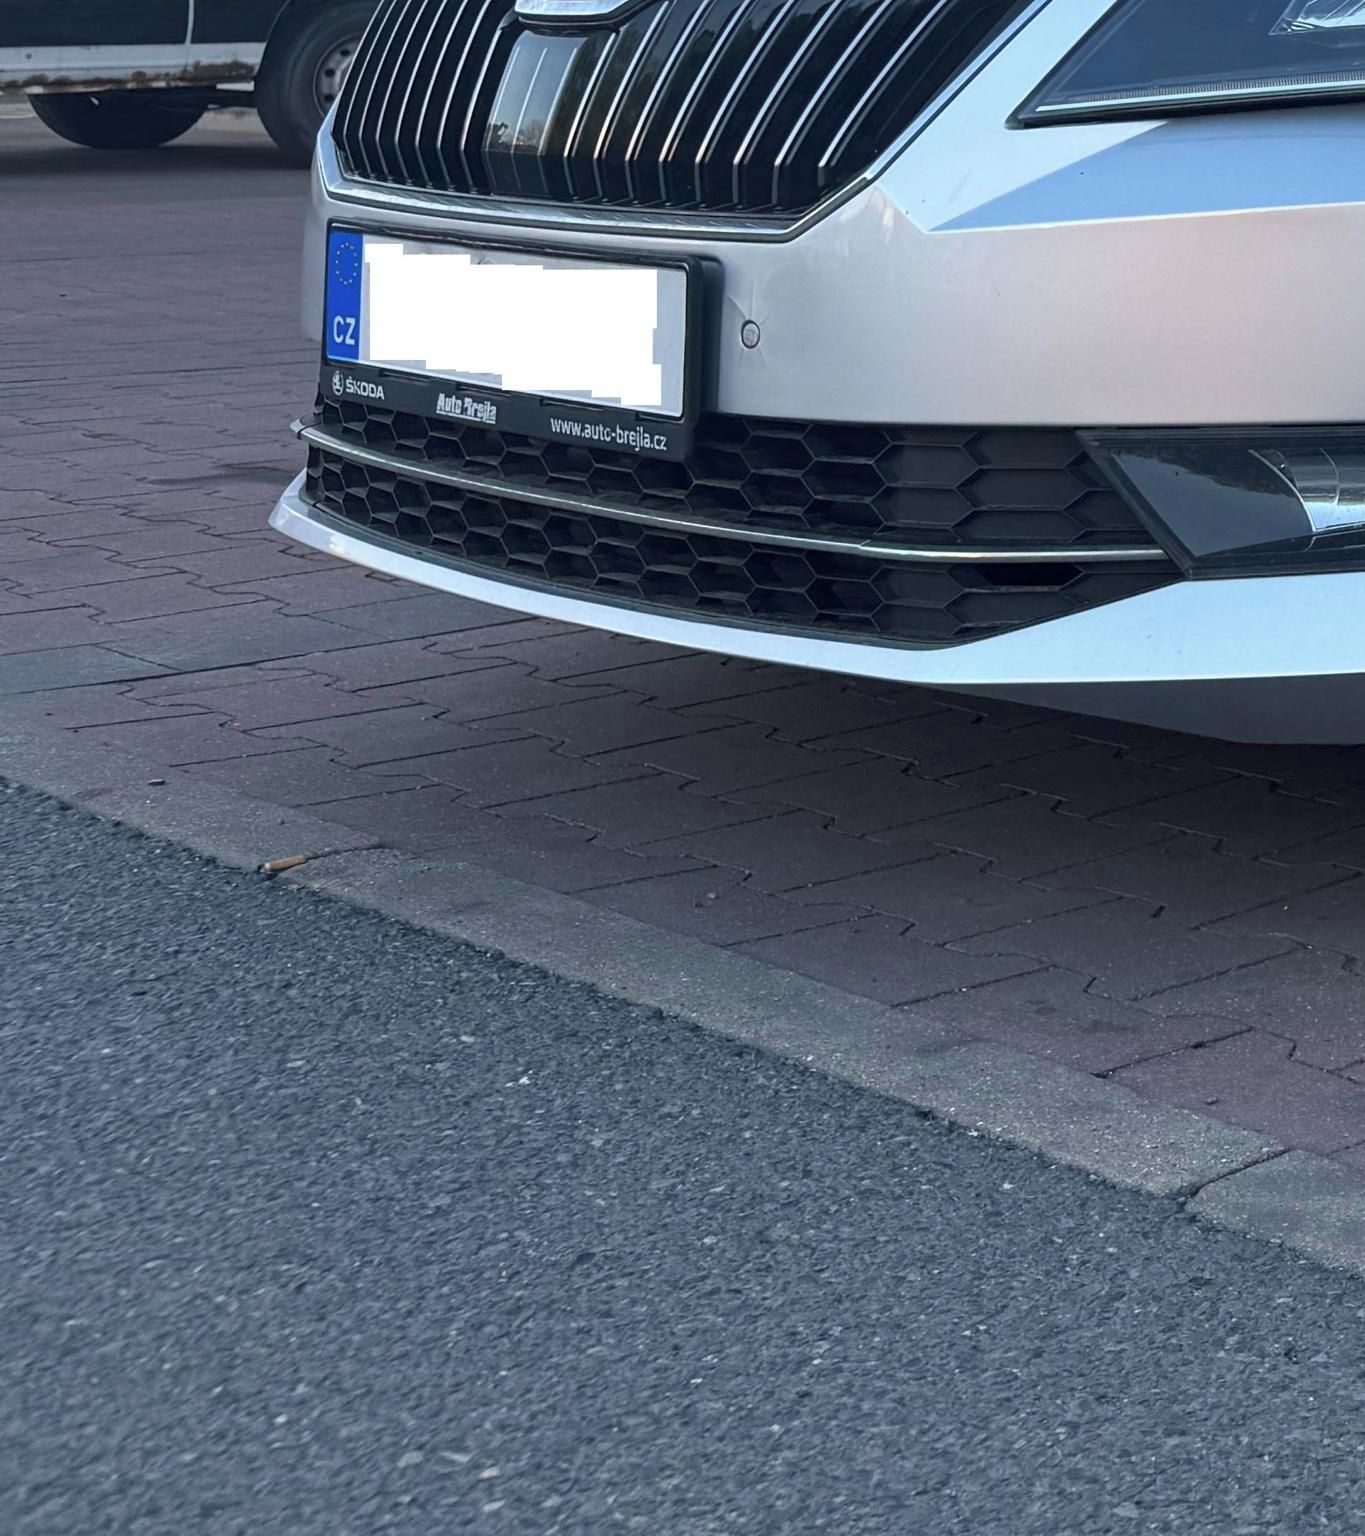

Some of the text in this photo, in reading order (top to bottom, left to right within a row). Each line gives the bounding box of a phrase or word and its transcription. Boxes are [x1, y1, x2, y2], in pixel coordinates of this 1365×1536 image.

[332, 315, 356, 346] CZ
[345, 375, 385, 400] ŠKODA
[436, 392, 462, 414] Auto
[550, 417, 668, 452] www.auto-brejla.cz
